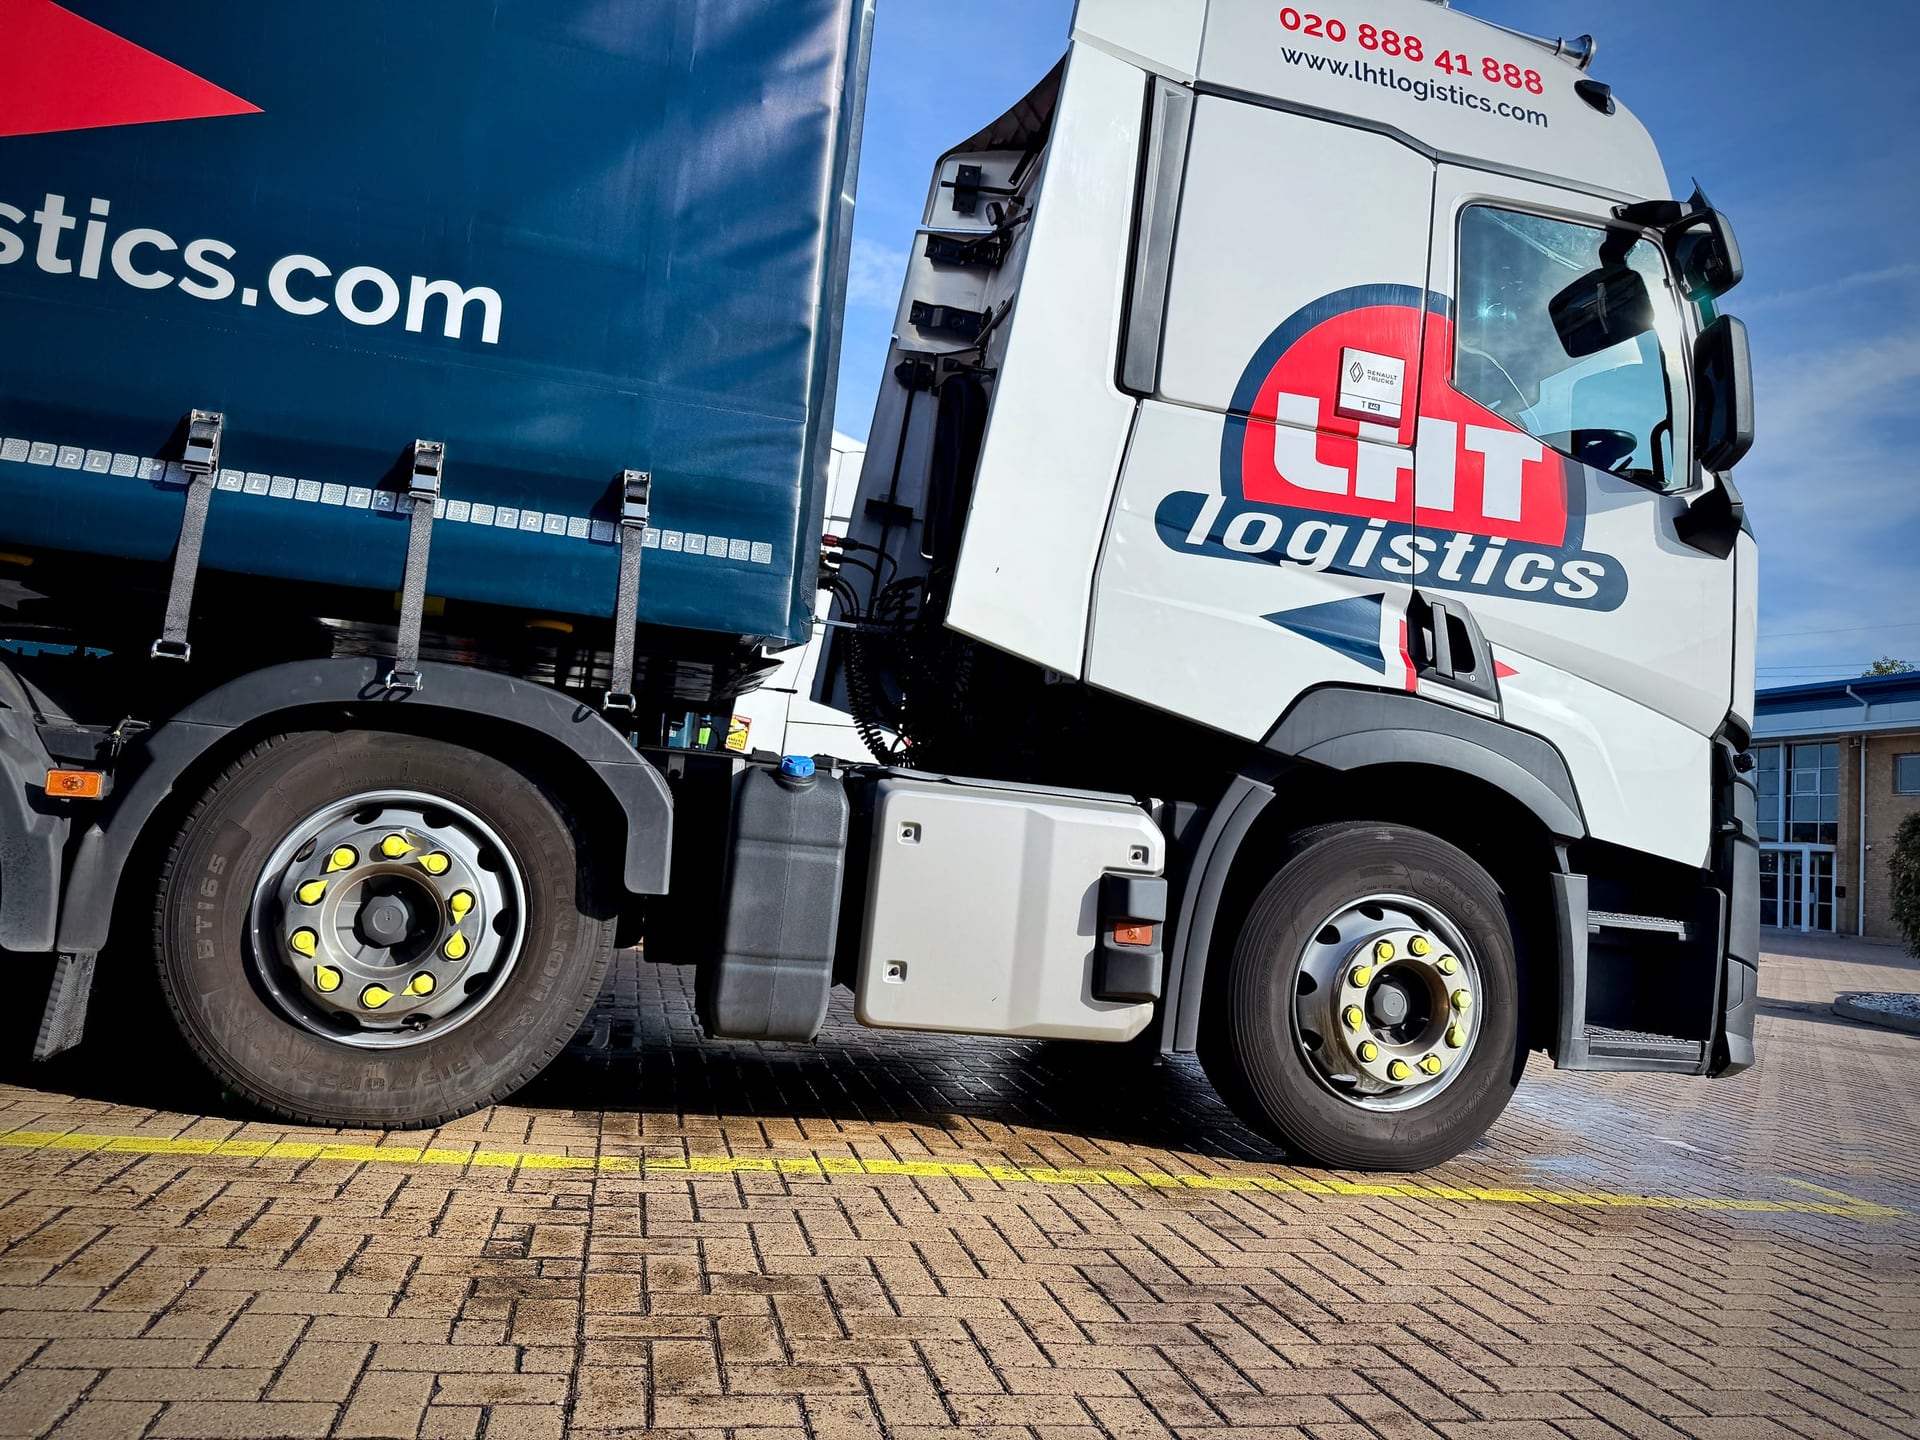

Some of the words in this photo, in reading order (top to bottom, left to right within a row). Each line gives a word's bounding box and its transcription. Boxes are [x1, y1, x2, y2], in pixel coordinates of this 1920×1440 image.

[1279, 7, 1346, 43] 020
[1358, 23, 1424, 62] 888
[1434, 50, 1473, 76] 41
[1481, 57, 1544, 95] 888
[1280, 46, 1549, 128] www.lhtlogistics.com
[1367, 369, 1397, 381] RENAULT
[1368, 375, 1394, 386] TRUCKS
[38, 449, 101, 467] TRL
[354, 493, 413, 509] TRL
[503, 513, 560, 529] TRL
[1273, 392, 1543, 522] LHT
[1185, 495, 1605, 600] logistics
[195, 853, 228, 960] BT165
